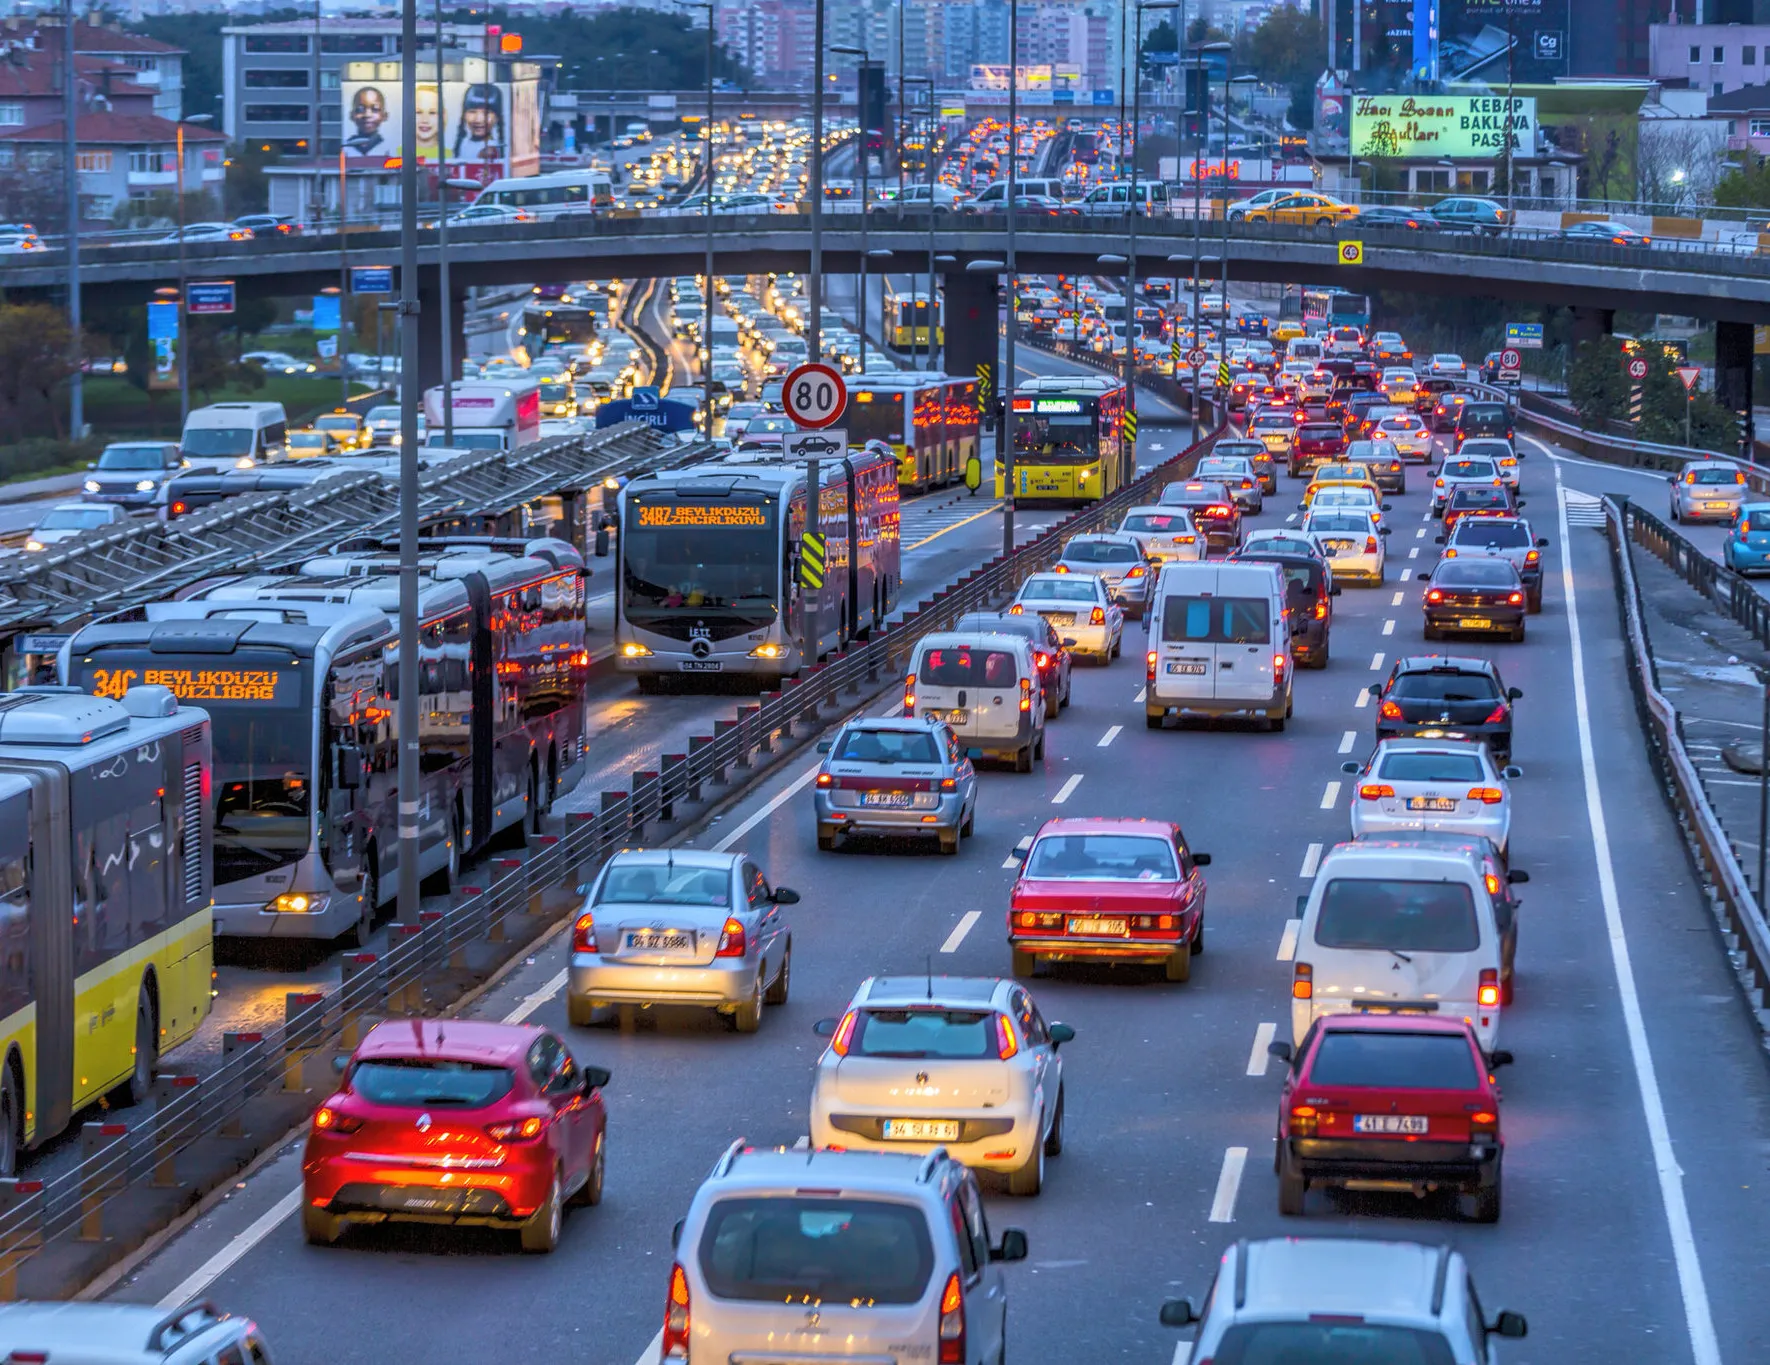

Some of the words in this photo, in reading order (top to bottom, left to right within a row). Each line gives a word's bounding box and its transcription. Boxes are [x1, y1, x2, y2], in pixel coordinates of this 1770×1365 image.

[1470, 98, 1524, 113] KEBAP
[1460, 116, 1530, 130] BAKLAVA
[1190, 160, 1239, 180] Gold
[1504, 354, 1517, 364] 80
[796, 382, 832, 411] 80
